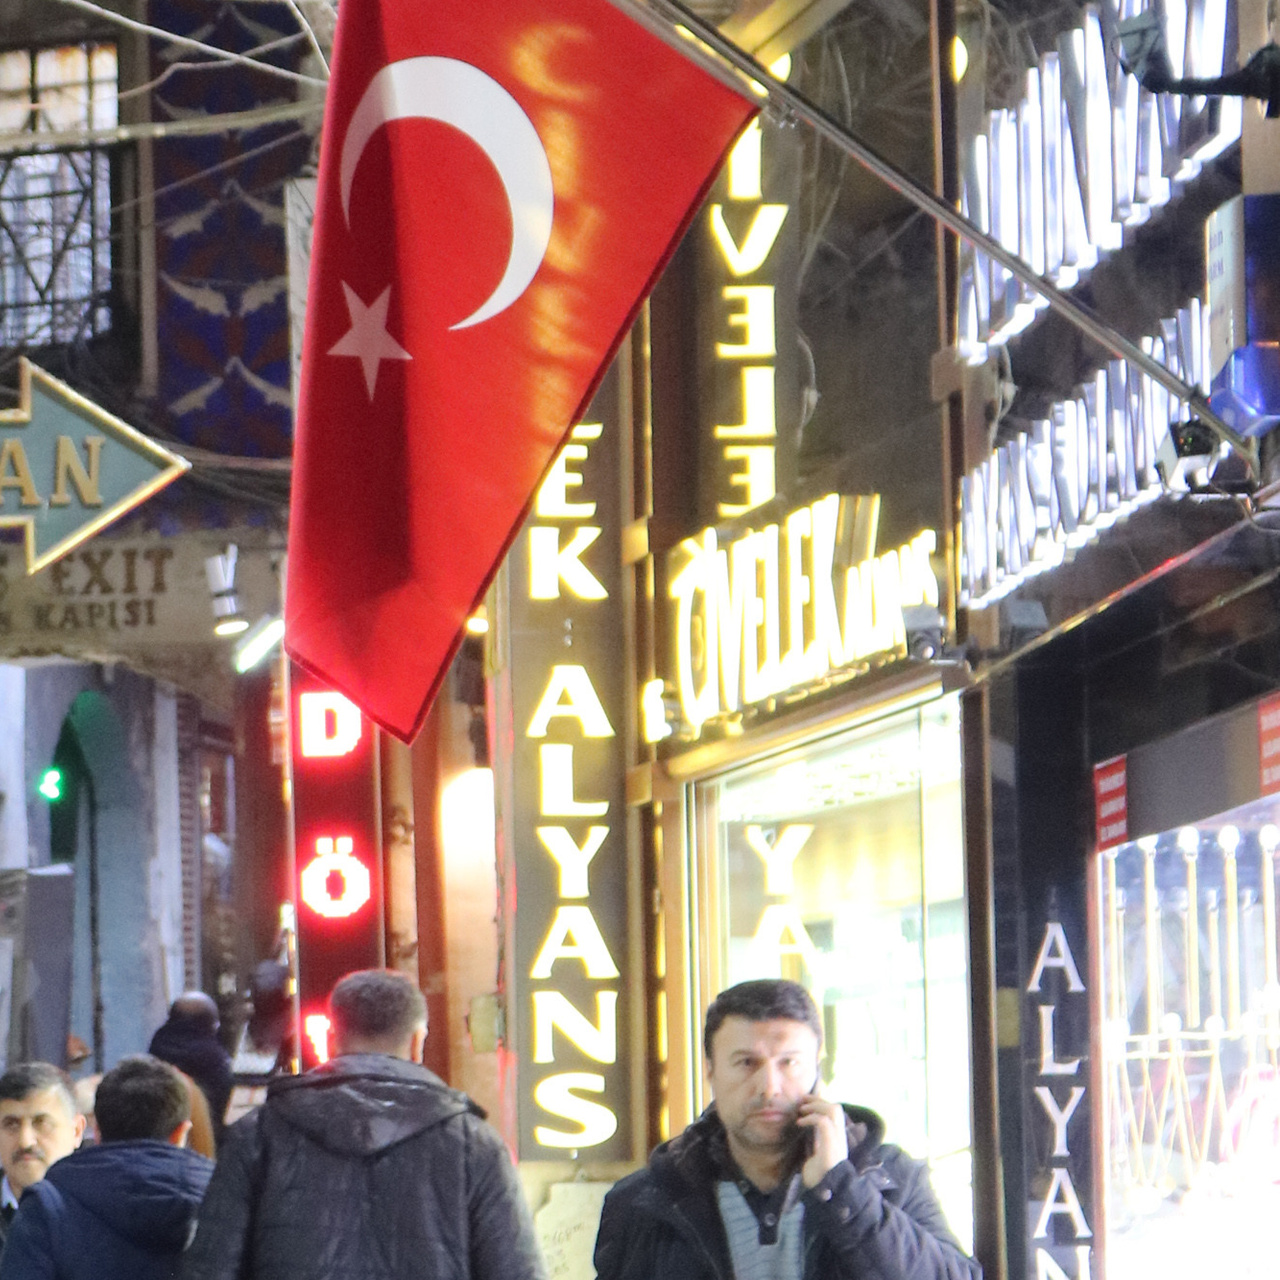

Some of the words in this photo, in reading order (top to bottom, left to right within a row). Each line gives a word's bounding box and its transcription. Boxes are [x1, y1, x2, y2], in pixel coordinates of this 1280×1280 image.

[51, 546, 174, 598] EXIT
[32, 598, 157, 631] KAPISI
[527, 665, 620, 1149] ALYANS
